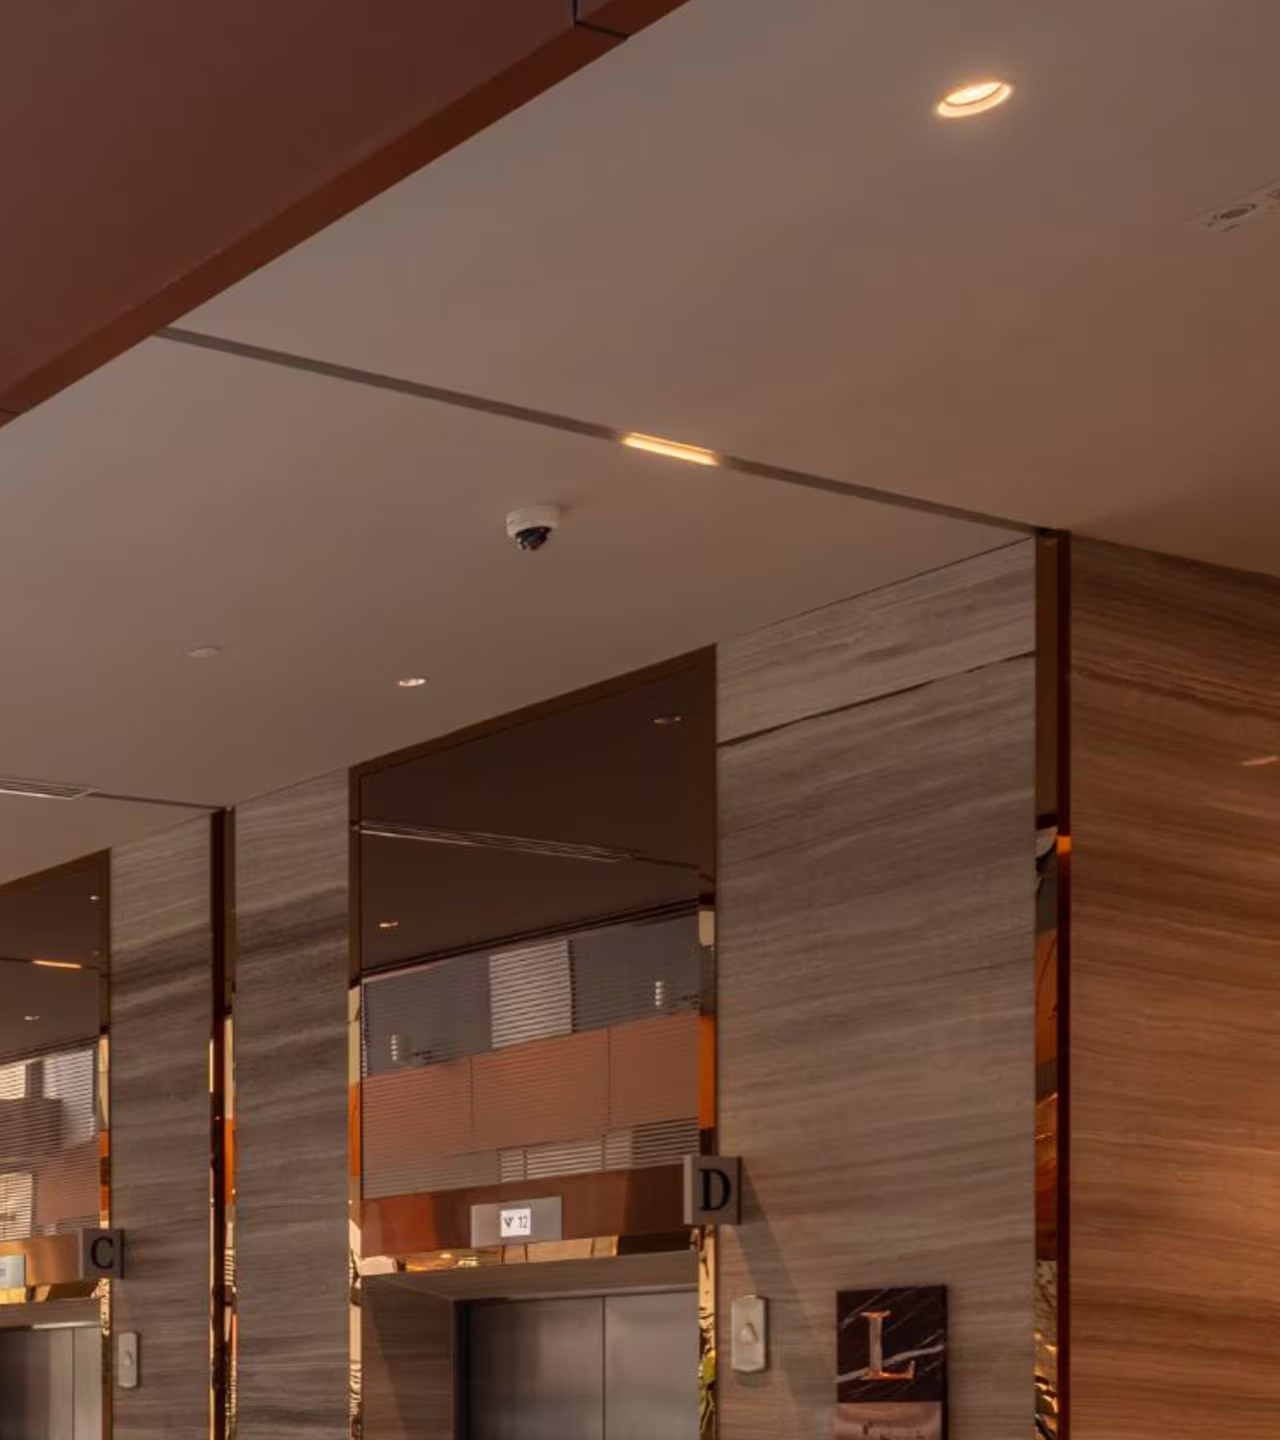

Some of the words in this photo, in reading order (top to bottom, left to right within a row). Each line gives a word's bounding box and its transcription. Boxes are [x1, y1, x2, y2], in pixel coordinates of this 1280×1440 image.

[699, 1167, 732, 1212] D
[91, 1235, 114, 1269] C
[859, 1309, 916, 1380] L
